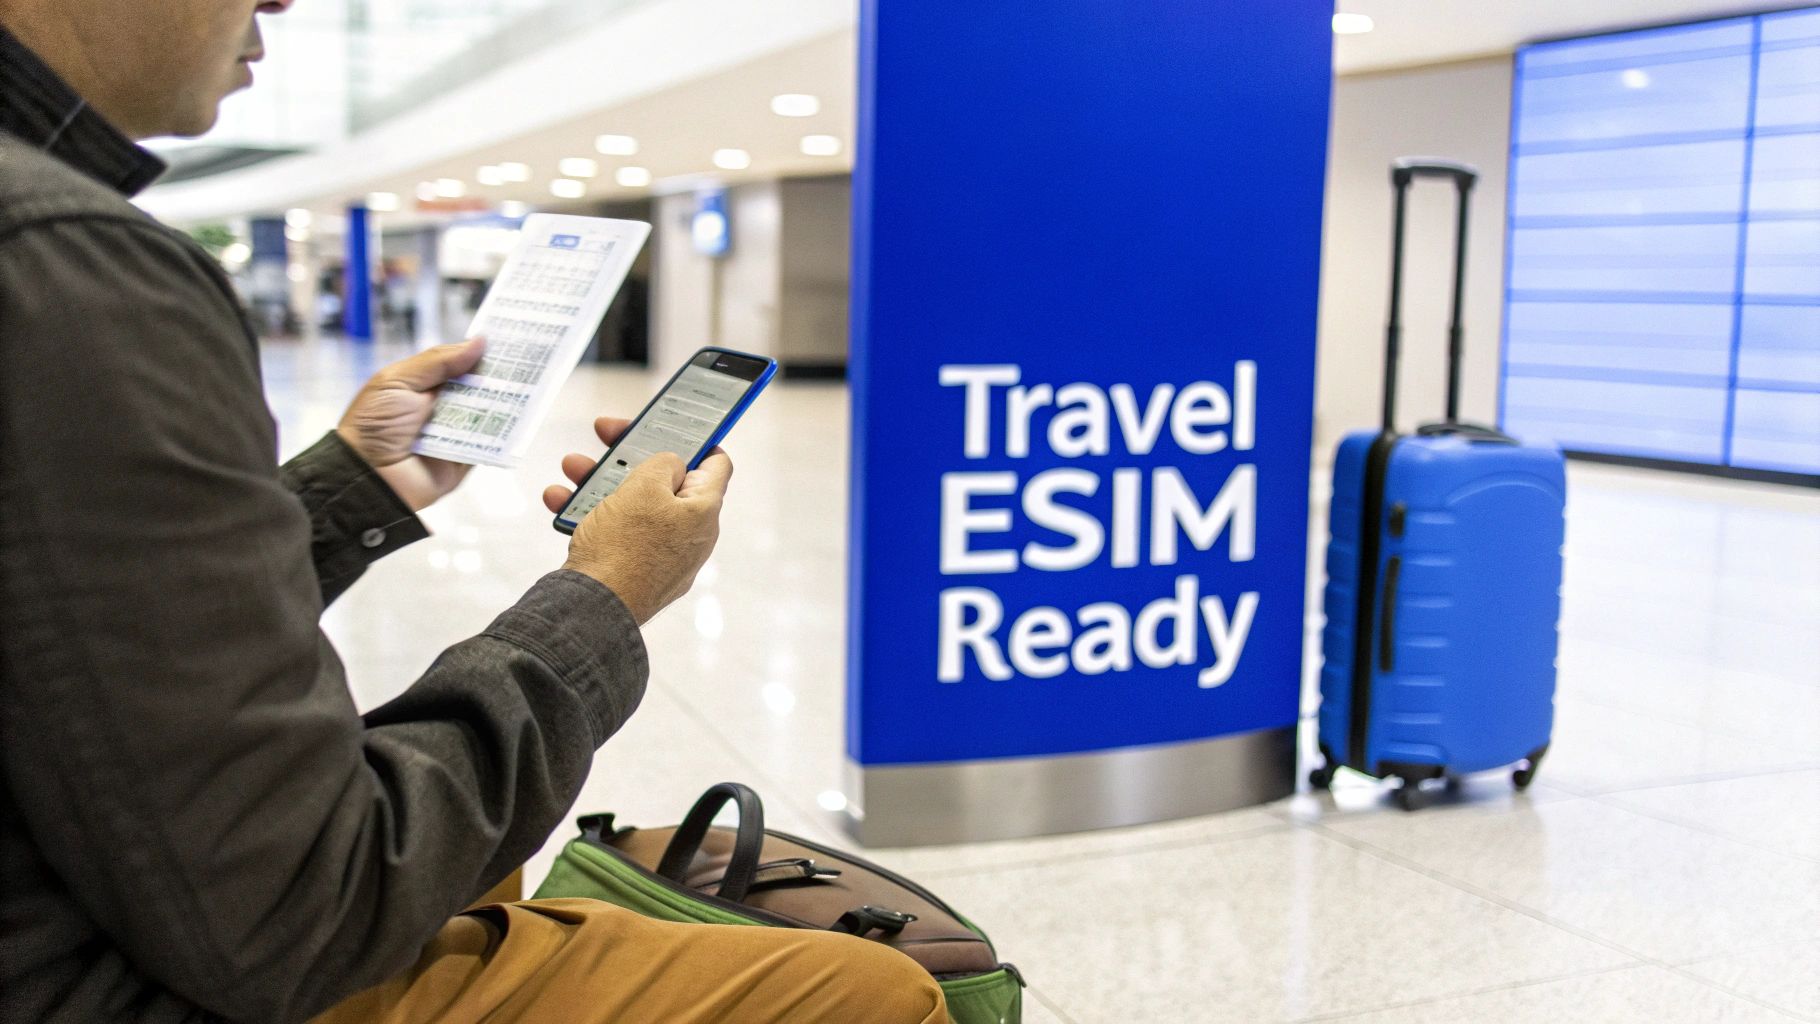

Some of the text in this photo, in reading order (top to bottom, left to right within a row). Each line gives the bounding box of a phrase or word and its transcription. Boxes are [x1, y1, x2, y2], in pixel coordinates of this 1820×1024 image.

[938, 360, 1257, 459] Travel
[939, 463, 1257, 575] ESIM
[937, 574, 1260, 689] Ready
